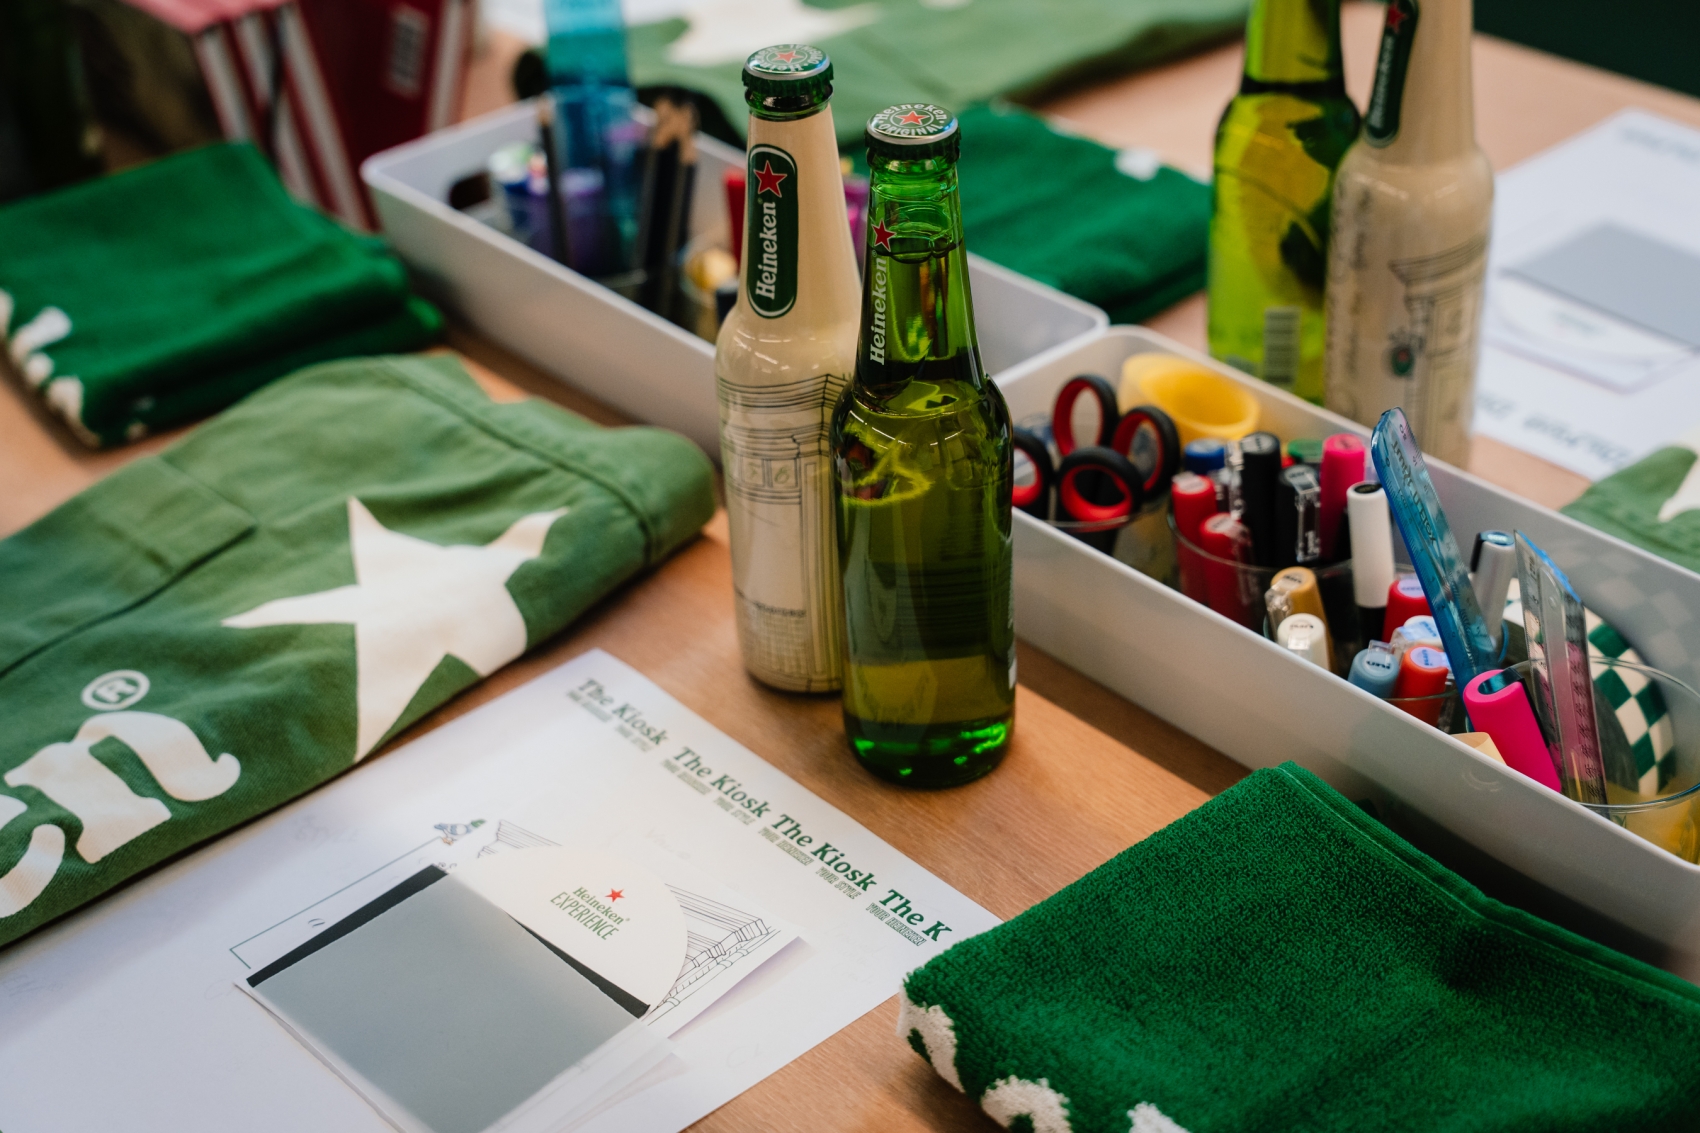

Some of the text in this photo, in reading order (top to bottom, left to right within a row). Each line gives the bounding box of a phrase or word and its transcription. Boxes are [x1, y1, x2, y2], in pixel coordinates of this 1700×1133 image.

[875, 103, 947, 121] Heineken
[878, 123, 943, 136] ORIGINAL
[755, 201, 778, 300] Heineken
[869, 257, 887, 366] Heineken
[578, 678, 614, 706] The
[612, 702, 669, 745] Kiosk
[673, 746, 712, 778] The
[710, 773, 771, 818] Kiosk
[771, 813, 813, 847] The
[810, 842, 877, 892] Kiosk
[879, 888, 924, 926] The
[550, 891, 619, 941] EXPERIENCE
[572, 886, 624, 925] Heineken
